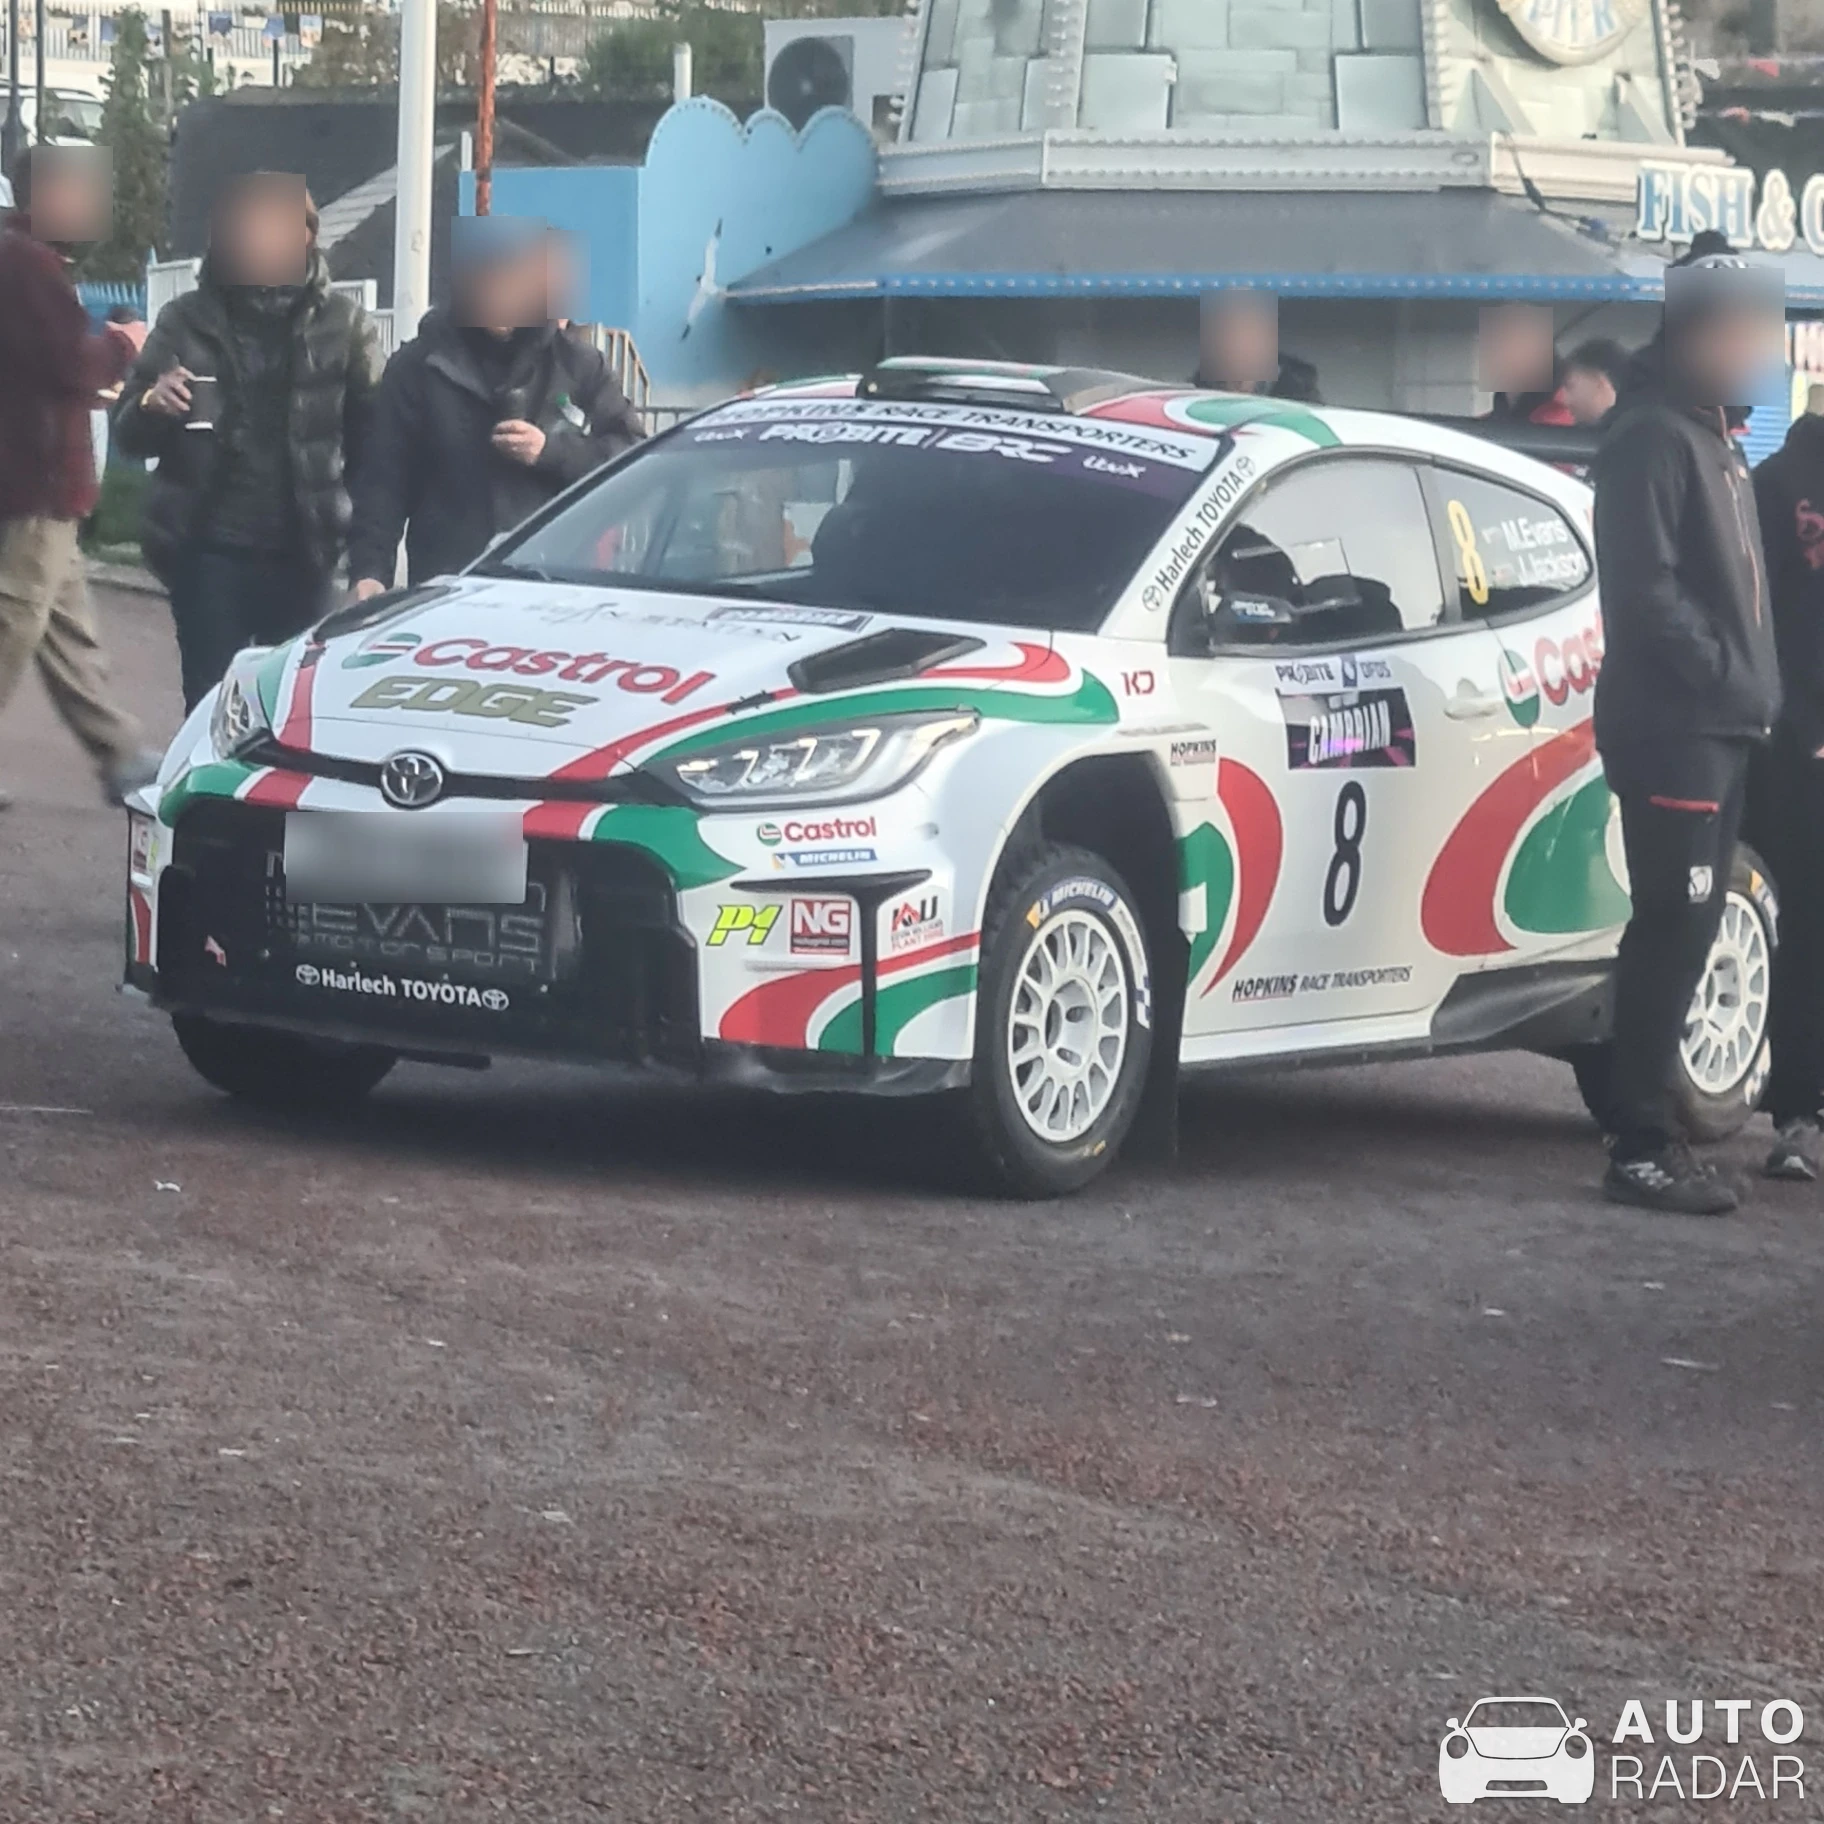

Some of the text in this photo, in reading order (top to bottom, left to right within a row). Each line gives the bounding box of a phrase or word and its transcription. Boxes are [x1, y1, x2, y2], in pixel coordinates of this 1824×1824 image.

[1637, 161, 1754, 248] FISH
[1757, 169, 1797, 250] &
[961, 409, 1196, 462] TRANSPORTERS
[1154, 470, 1245, 592] Harlech TOYOTA
[1447, 499, 1489, 605] 8
[413, 637, 717, 705] Castrol
[348, 675, 600, 728] EDGE
[1308, 699, 1391, 765] CAMBRIAN
[784, 816, 877, 843] Castrol
[1322, 780, 1367, 928] 8
[799, 850, 871, 864] MICHELIN
[793, 901, 850, 935] NG
[1051, 881, 1115, 907] MICHELIN
[705, 903, 784, 946] P1
[321, 966, 483, 1009] Harlech TOYOTA
[1232, 974, 1298, 1001] HOPKINS
